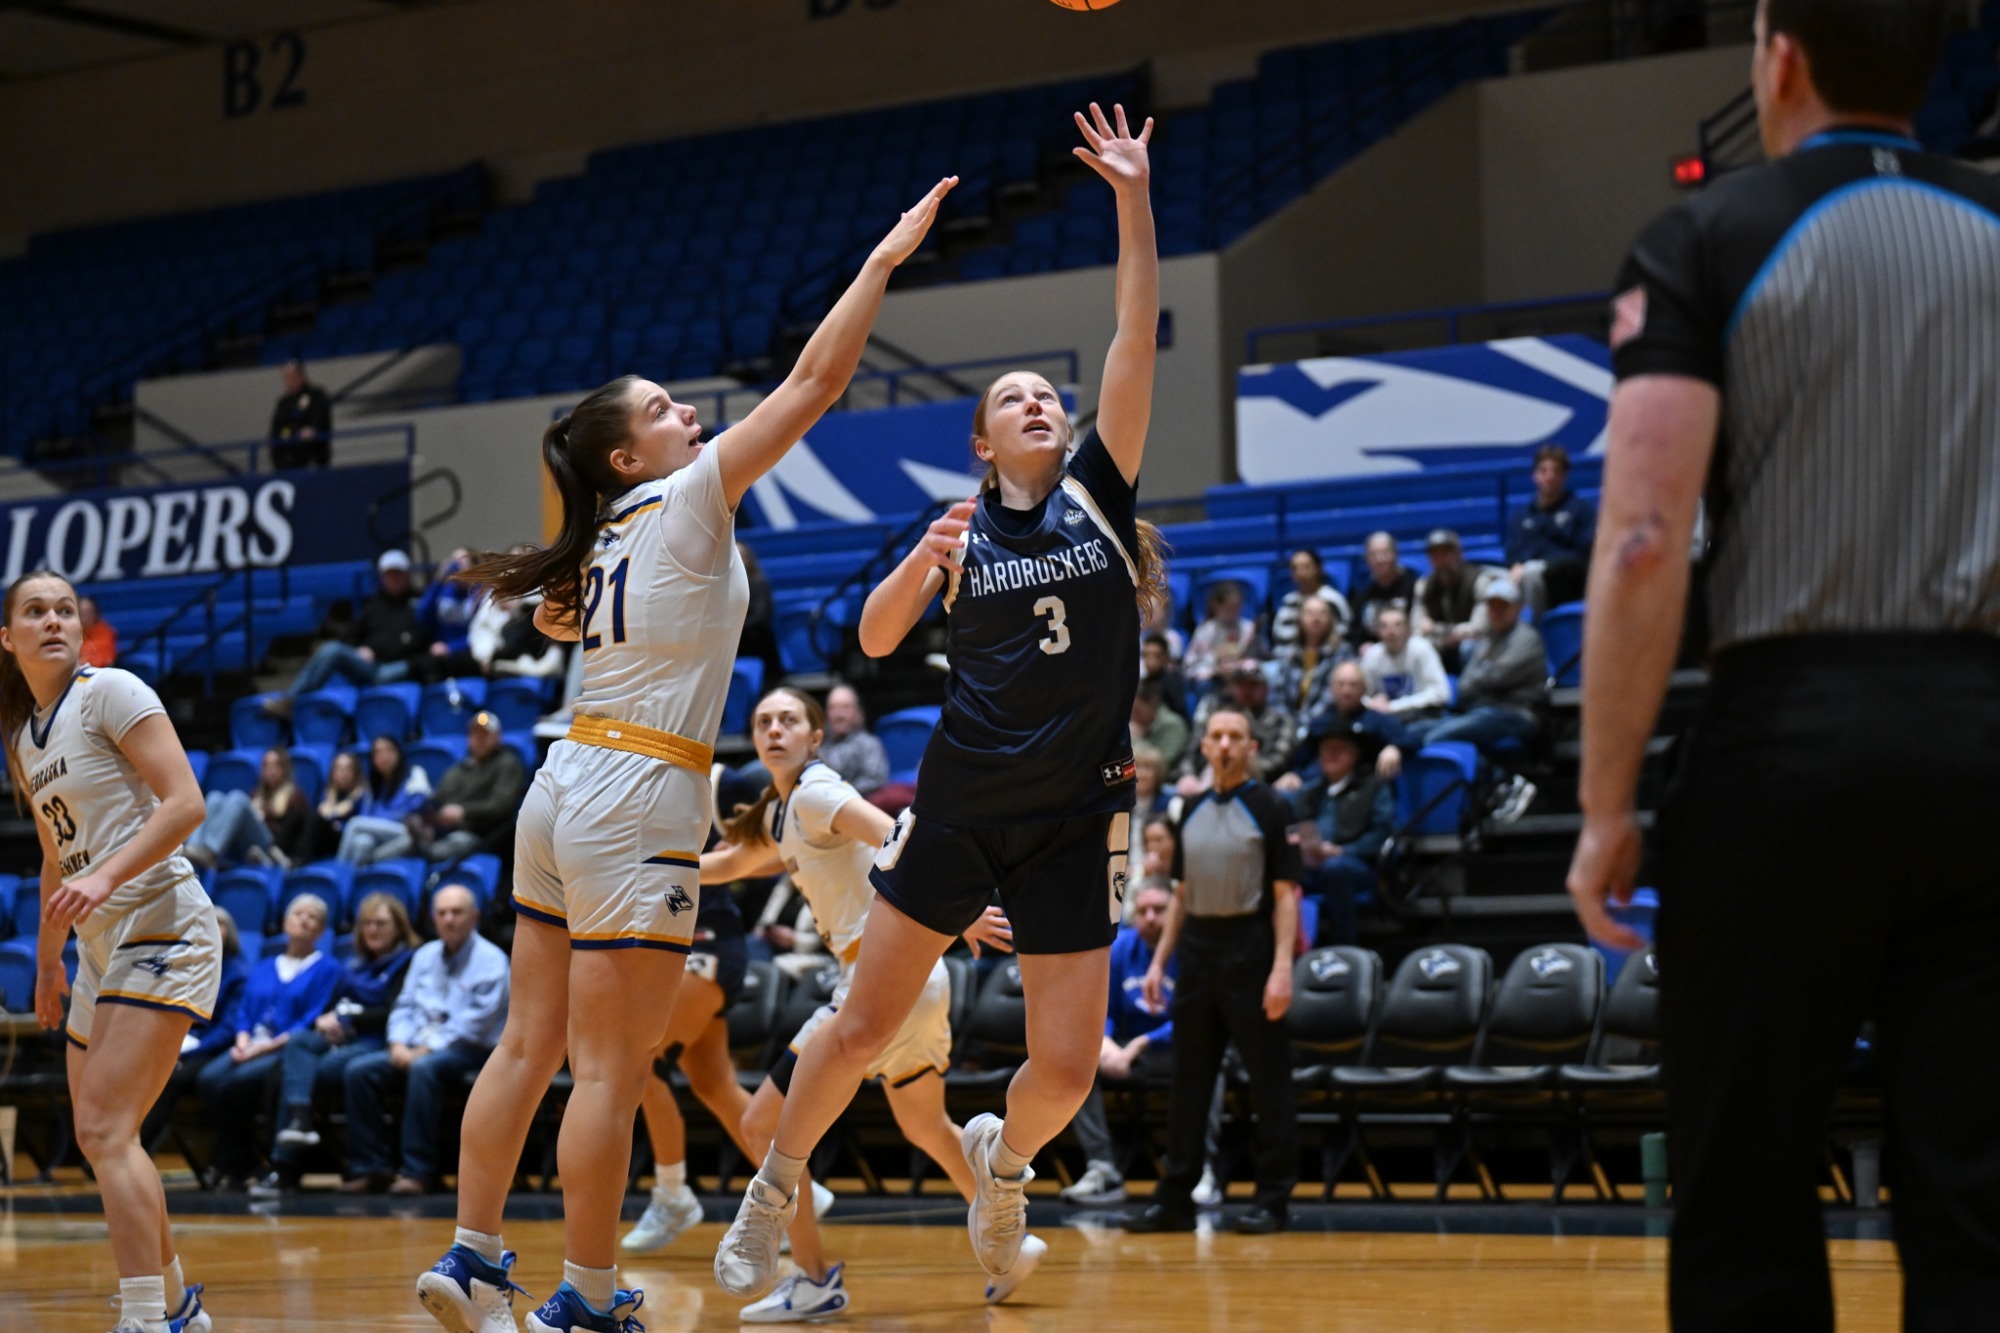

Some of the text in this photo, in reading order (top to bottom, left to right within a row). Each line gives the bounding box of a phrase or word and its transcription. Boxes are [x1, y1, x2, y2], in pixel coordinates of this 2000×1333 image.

[224, 30, 307, 117] B2
[2, 479, 296, 588] LOPERS
[968, 538, 1109, 597] HARDROCKERS
[582, 555, 630, 651] 21
[1033, 595, 1071, 655] 3
[30, 756, 68, 794] EBRASKA
[41, 795, 77, 847] 33
